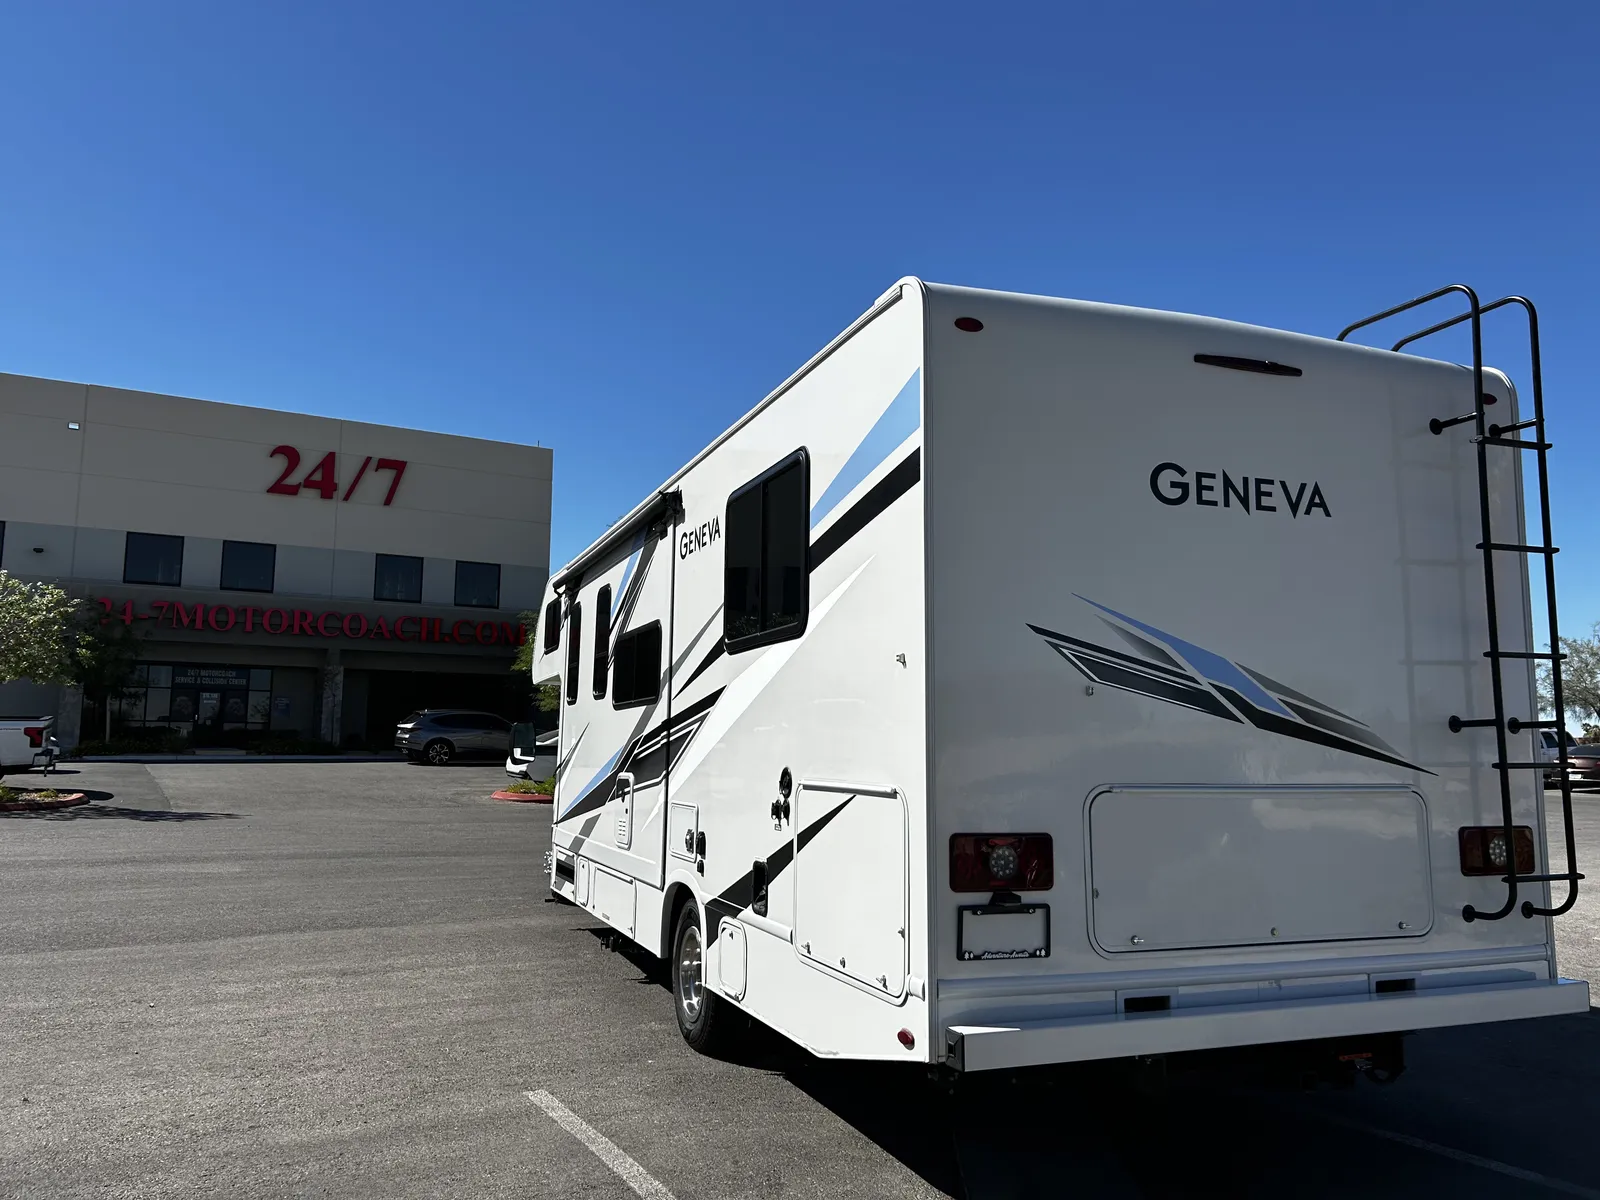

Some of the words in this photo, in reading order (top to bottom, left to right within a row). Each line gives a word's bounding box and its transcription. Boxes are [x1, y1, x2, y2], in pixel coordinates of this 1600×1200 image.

[266, 445, 408, 506] 24/7
[1150, 462, 1332, 519] GENEVA
[680, 515, 721, 560] GENEVA
[175, 676, 195, 684] SERVICE
[201, 677, 227, 685] COLLISION
[200, 669, 236, 677] MOTORCOACH
